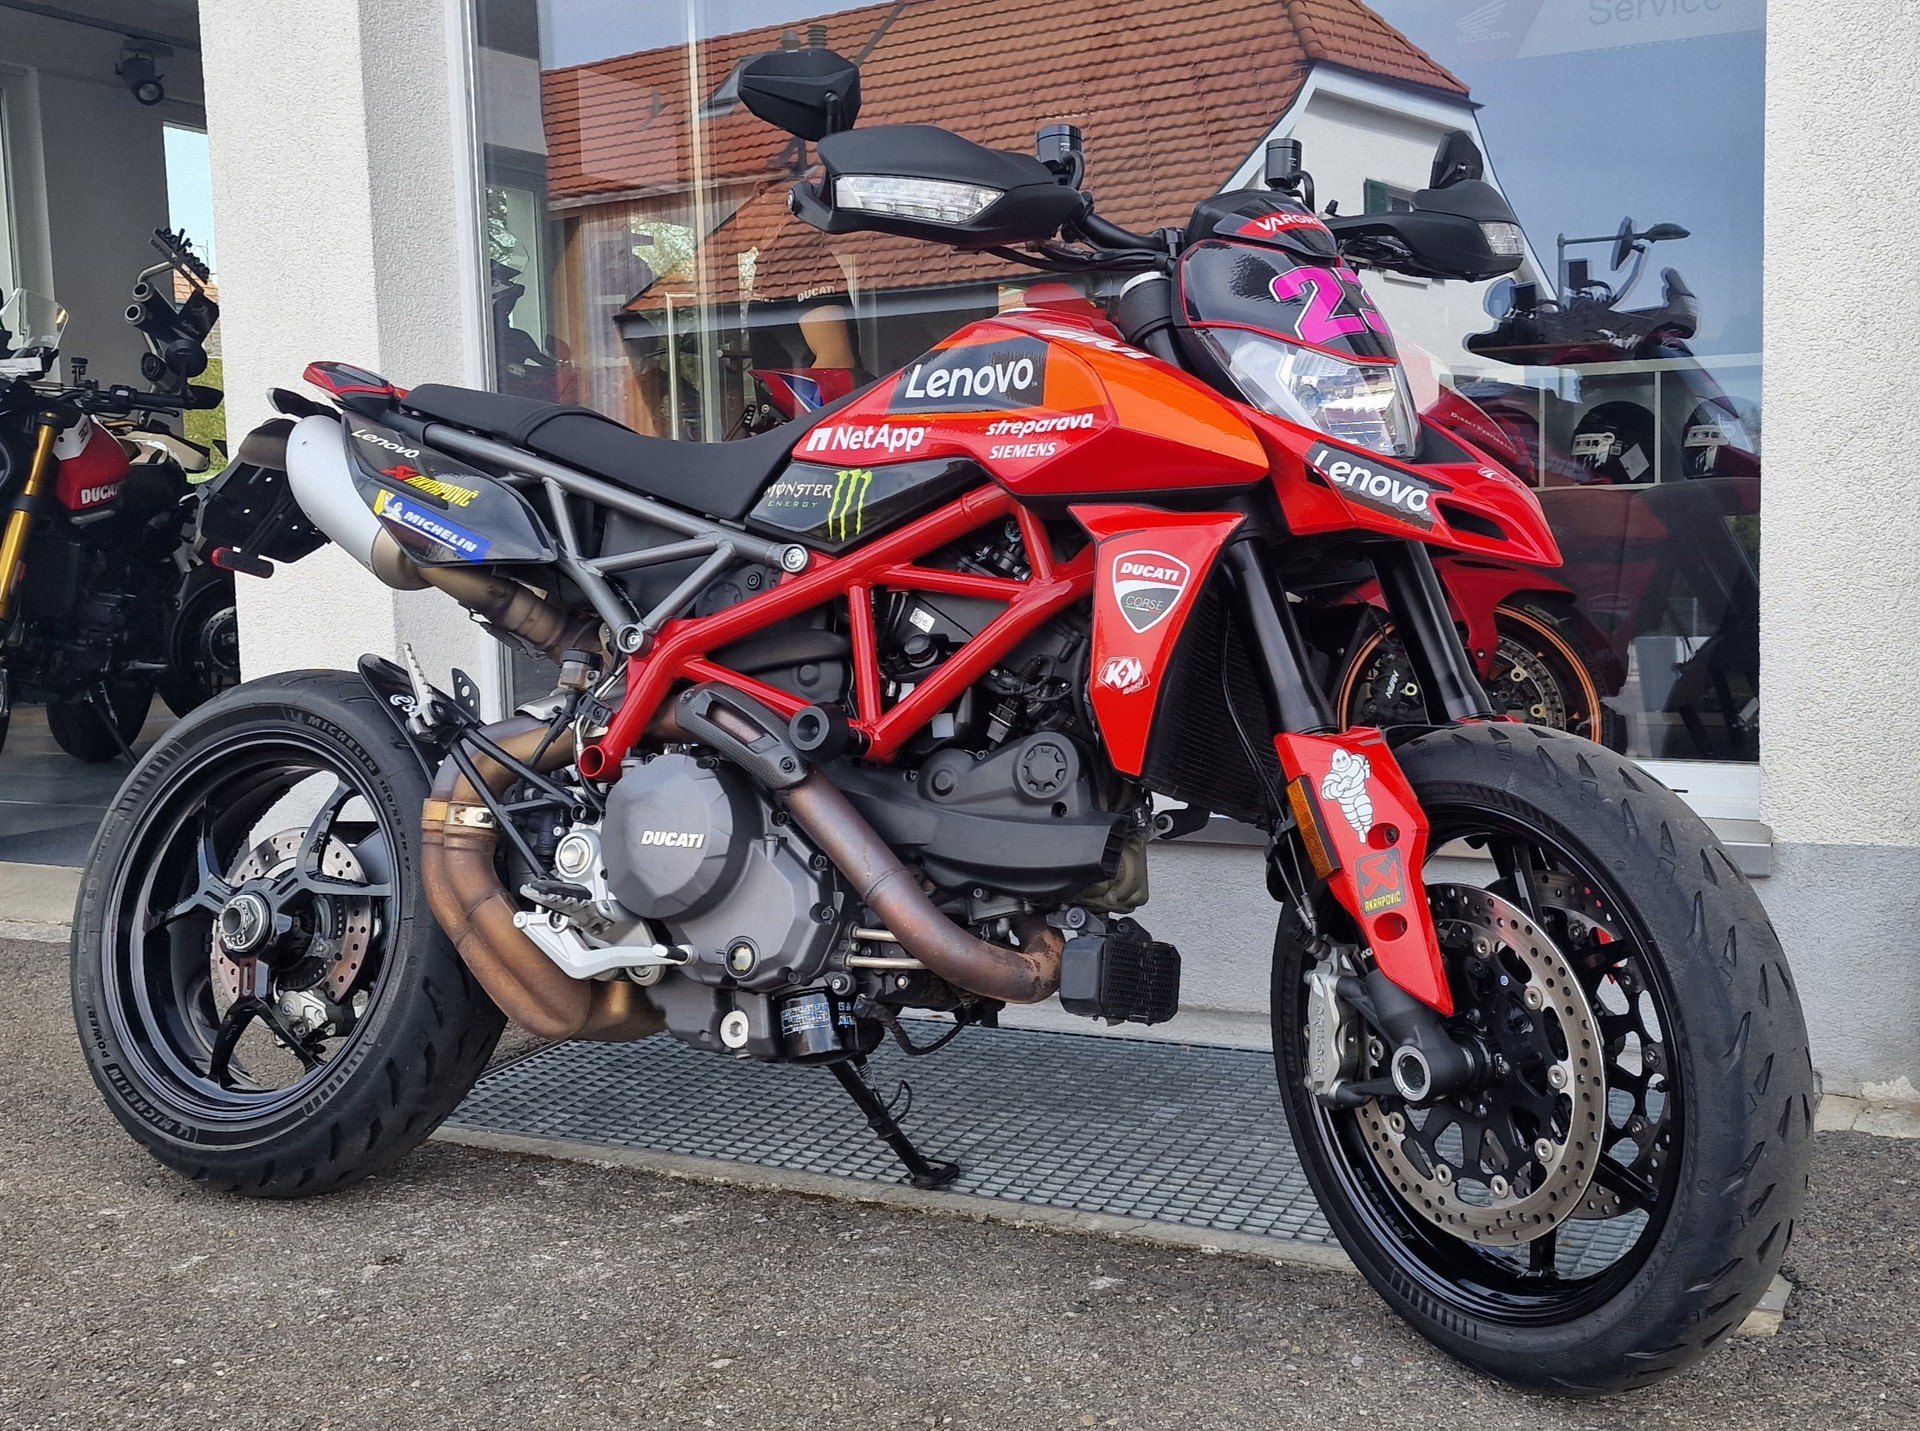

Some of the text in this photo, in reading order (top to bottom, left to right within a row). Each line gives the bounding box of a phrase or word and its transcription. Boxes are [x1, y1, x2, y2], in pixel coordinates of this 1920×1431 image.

[1588, 0, 1722, 26] Service
[1457, 30, 1512, 44] HONDA
[797, 285, 836, 303] DUCATI
[904, 358, 1034, 399] Lenovo
[831, 424, 925, 453] NetApp
[985, 412, 1094, 440] streparava
[351, 429, 420, 459] Lenovo
[989, 441, 1057, 460] SIEMENS
[763, 480, 833, 499] MONSTER
[1312, 449, 1430, 512] Lenovo
[767, 500, 818, 509] ENERGY
[403, 511, 478, 553] MICHELIN
[1120, 561, 1180, 582] DUCATI
[1125, 595, 1164, 611] CORSE
[307, 715, 377, 773] MICHELIN
[641, 830, 704, 849] DUCATI
[107, 1066, 174, 1131] MICHELIN
